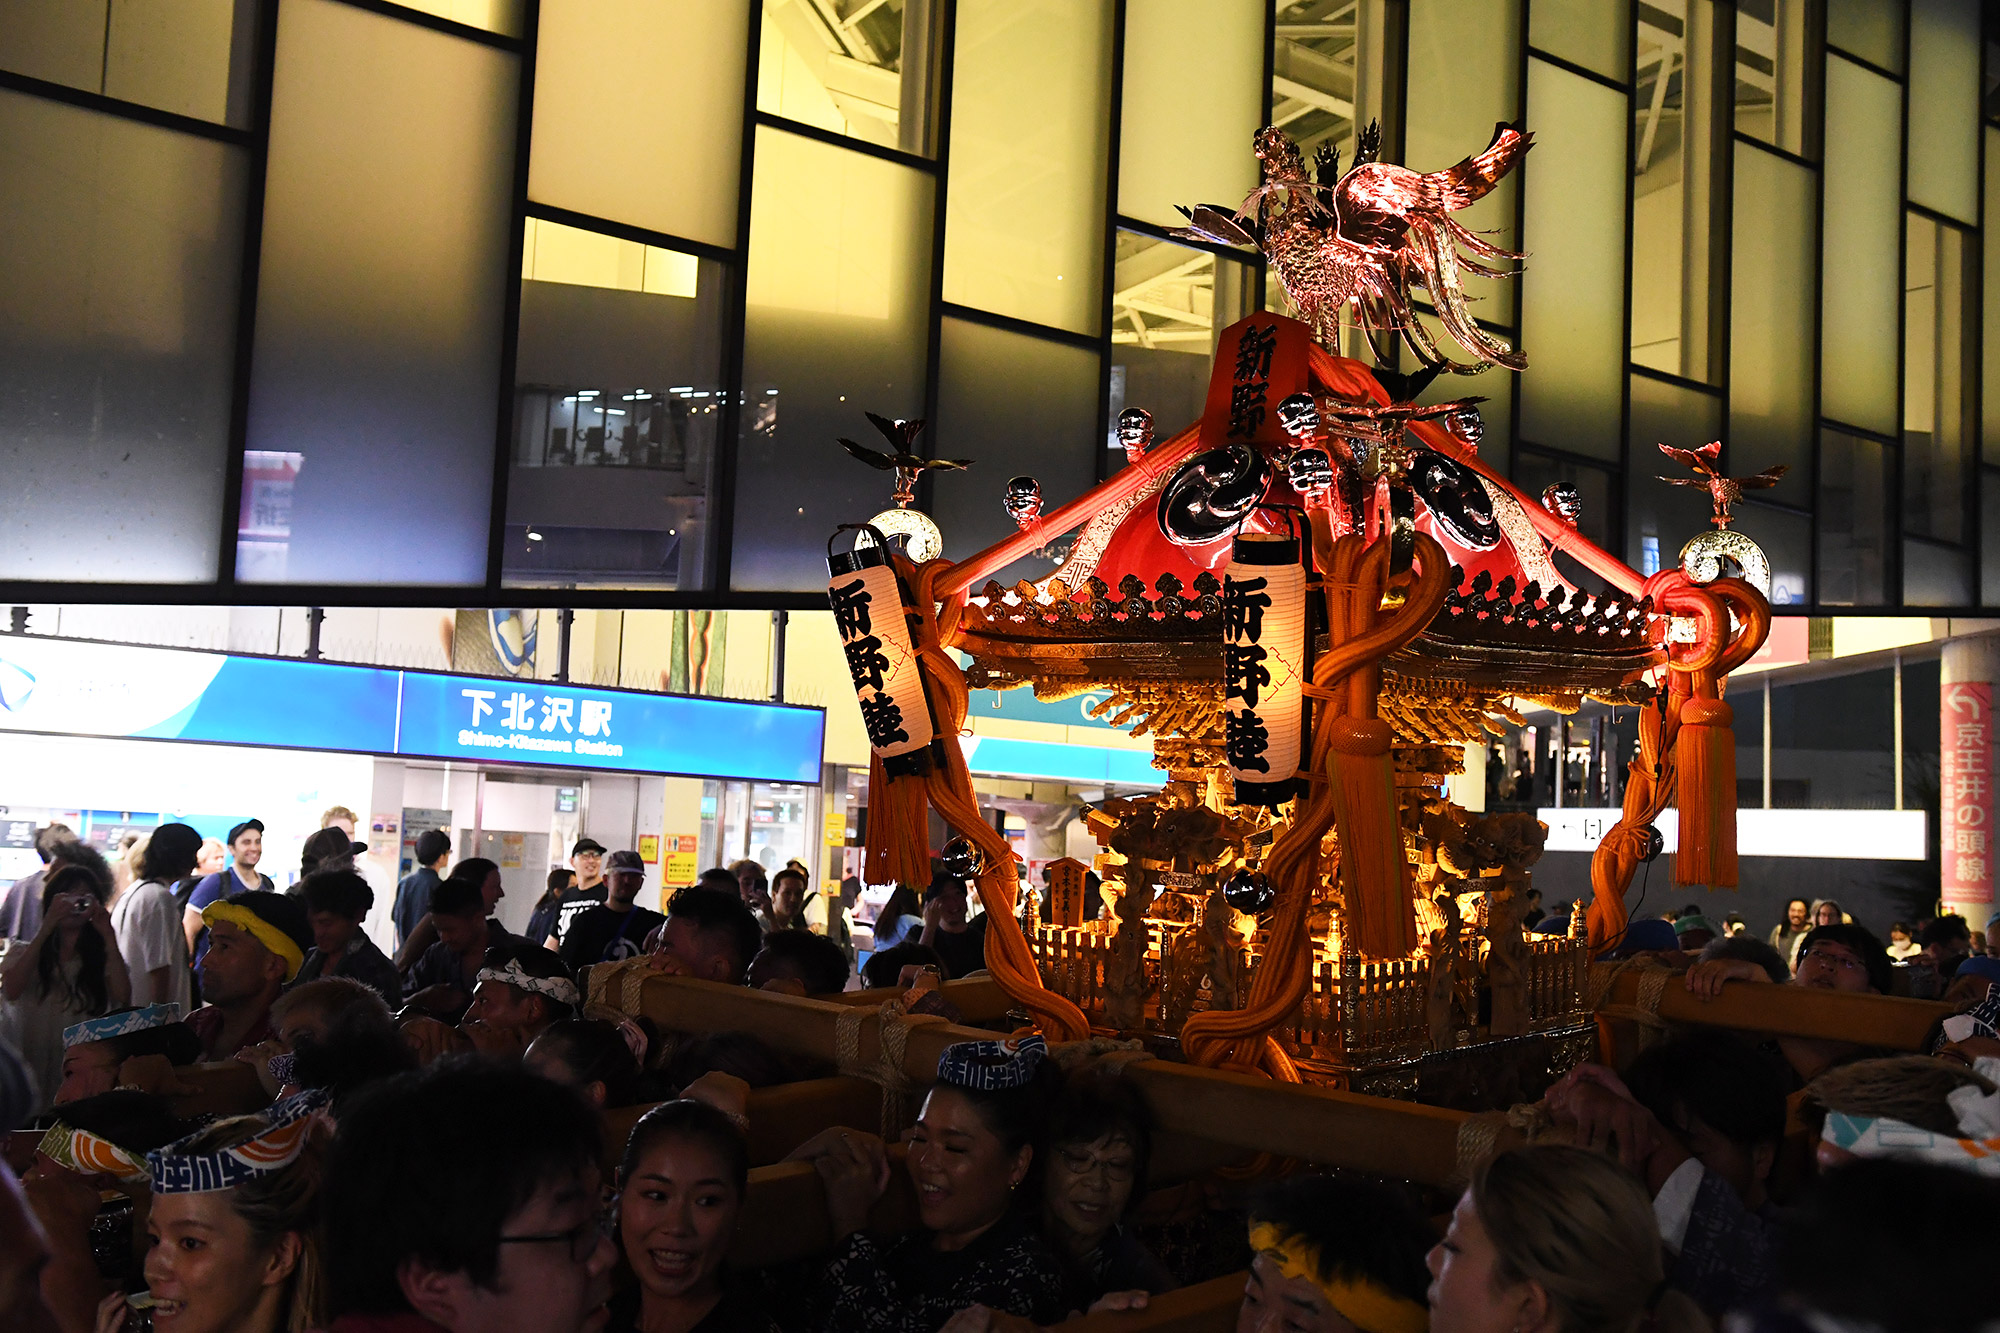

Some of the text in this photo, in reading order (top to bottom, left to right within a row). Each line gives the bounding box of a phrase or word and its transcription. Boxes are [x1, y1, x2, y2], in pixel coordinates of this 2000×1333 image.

[1229, 324, 1277, 438] 新野
[458, 729, 624, 757] Shimo-Kitazawa Station
[461, 689, 613, 737] 下北沢駅
[1956, 722, 1985, 881] 京王井の頭線
